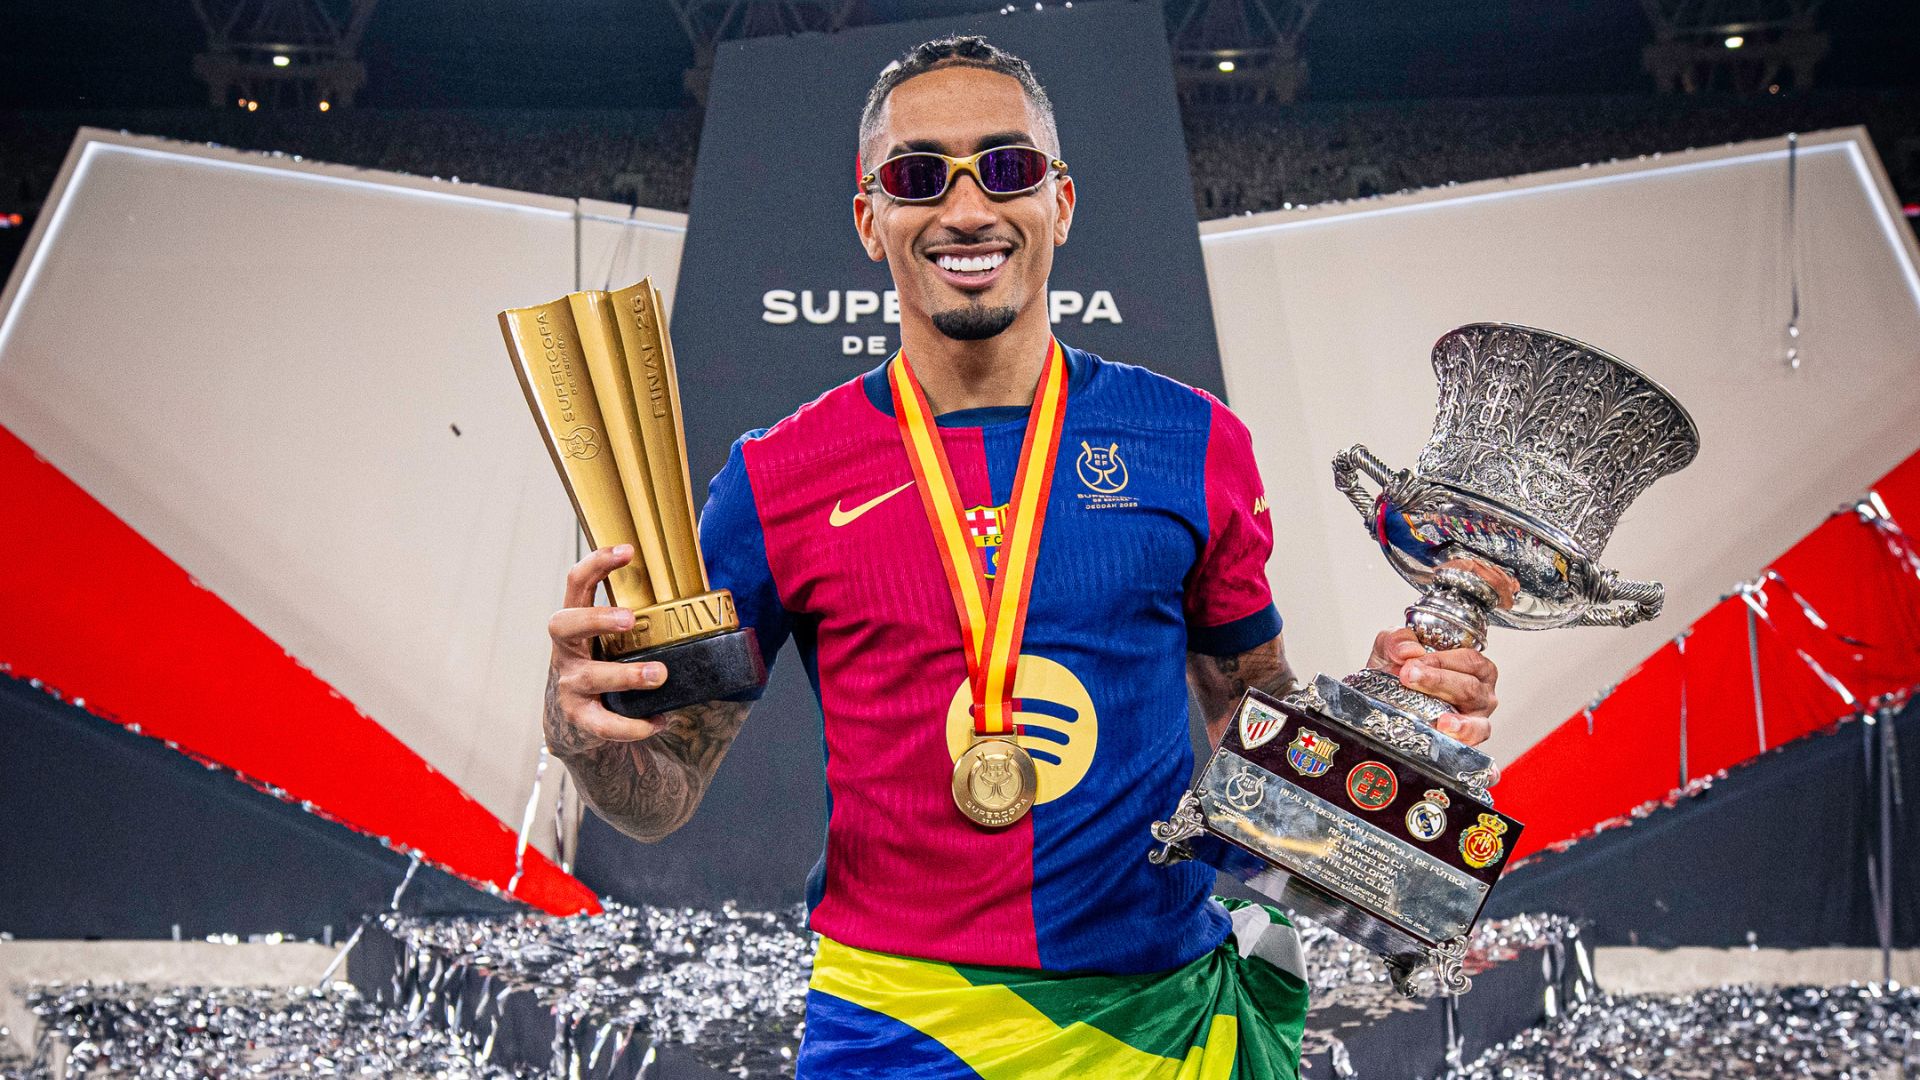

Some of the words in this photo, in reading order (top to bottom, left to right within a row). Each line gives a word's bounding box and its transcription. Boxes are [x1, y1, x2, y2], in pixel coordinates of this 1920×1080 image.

[630, 294, 650, 331] 25
[762, 290, 1123, 324] SUPEPA
[842, 336, 888, 355] DE
[537, 311, 576, 423] SUPERCOPA
[641, 343, 666, 419] FINAL
[664, 595, 736, 639] MVP
[1278, 786, 1306, 805] REAL
[1303, 797, 1366, 837] FEDERACIÓN
[1363, 828, 1416, 862] ESPAÑOLA
[1413, 856, 1430, 869] DE
[1428, 862, 1470, 890] FÚTBOL
[1326, 825, 1352, 844] REAL
[1351, 838, 1391, 864] MADRID
[1318, 851, 1365, 882] ATHLETIC
[1363, 875, 1392, 896] CLUB
[1340, 843, 1400, 879] BARCELONA
[1342, 853, 1396, 887] MALLORCA
